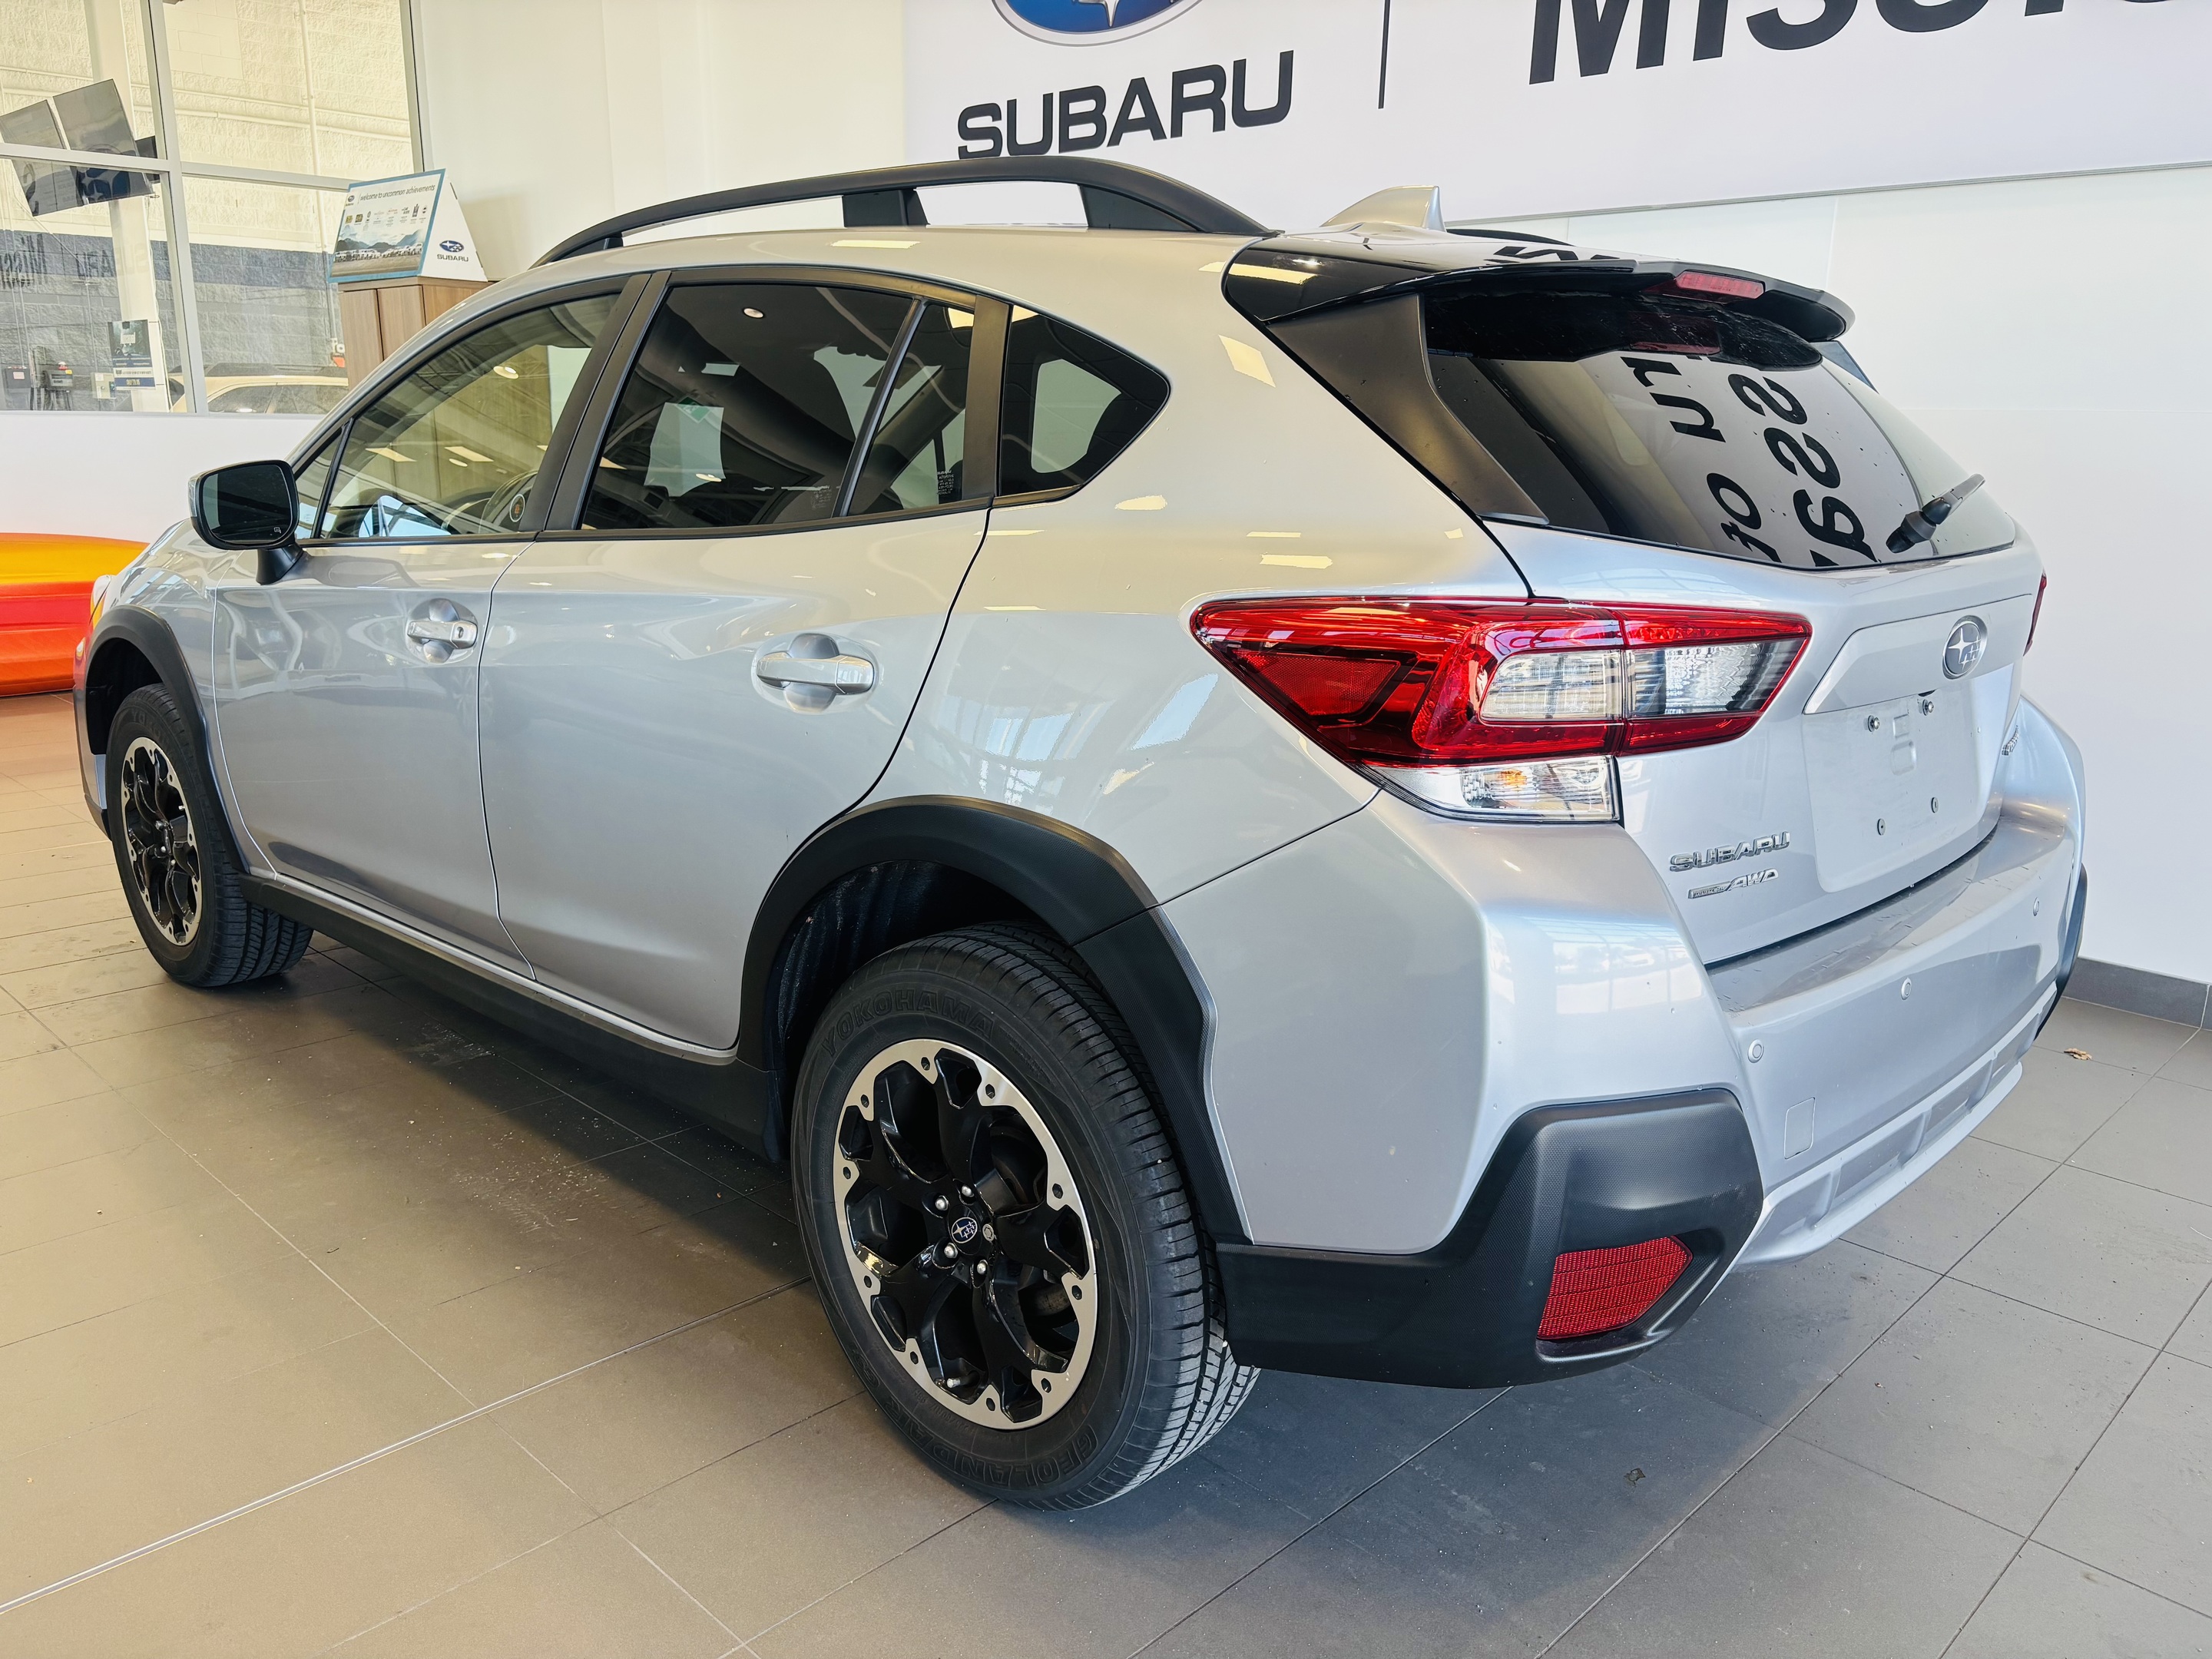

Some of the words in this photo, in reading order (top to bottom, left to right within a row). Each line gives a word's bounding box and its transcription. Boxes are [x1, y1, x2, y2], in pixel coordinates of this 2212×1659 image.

[958, 50, 1294, 160] SUBARU
[360, 192, 378, 201] welcome
[382, 189, 406, 198] uncommon
[406, 184, 435, 195] achievements
[436, 253, 470, 262] SUBARU
[1670, 831, 1790, 872] SUBARU
[1727, 868, 1779, 892] AWD
[821, 988, 995, 1058] YOKOHAMA
[884, 1398, 1098, 1487] GEOLANDAR
